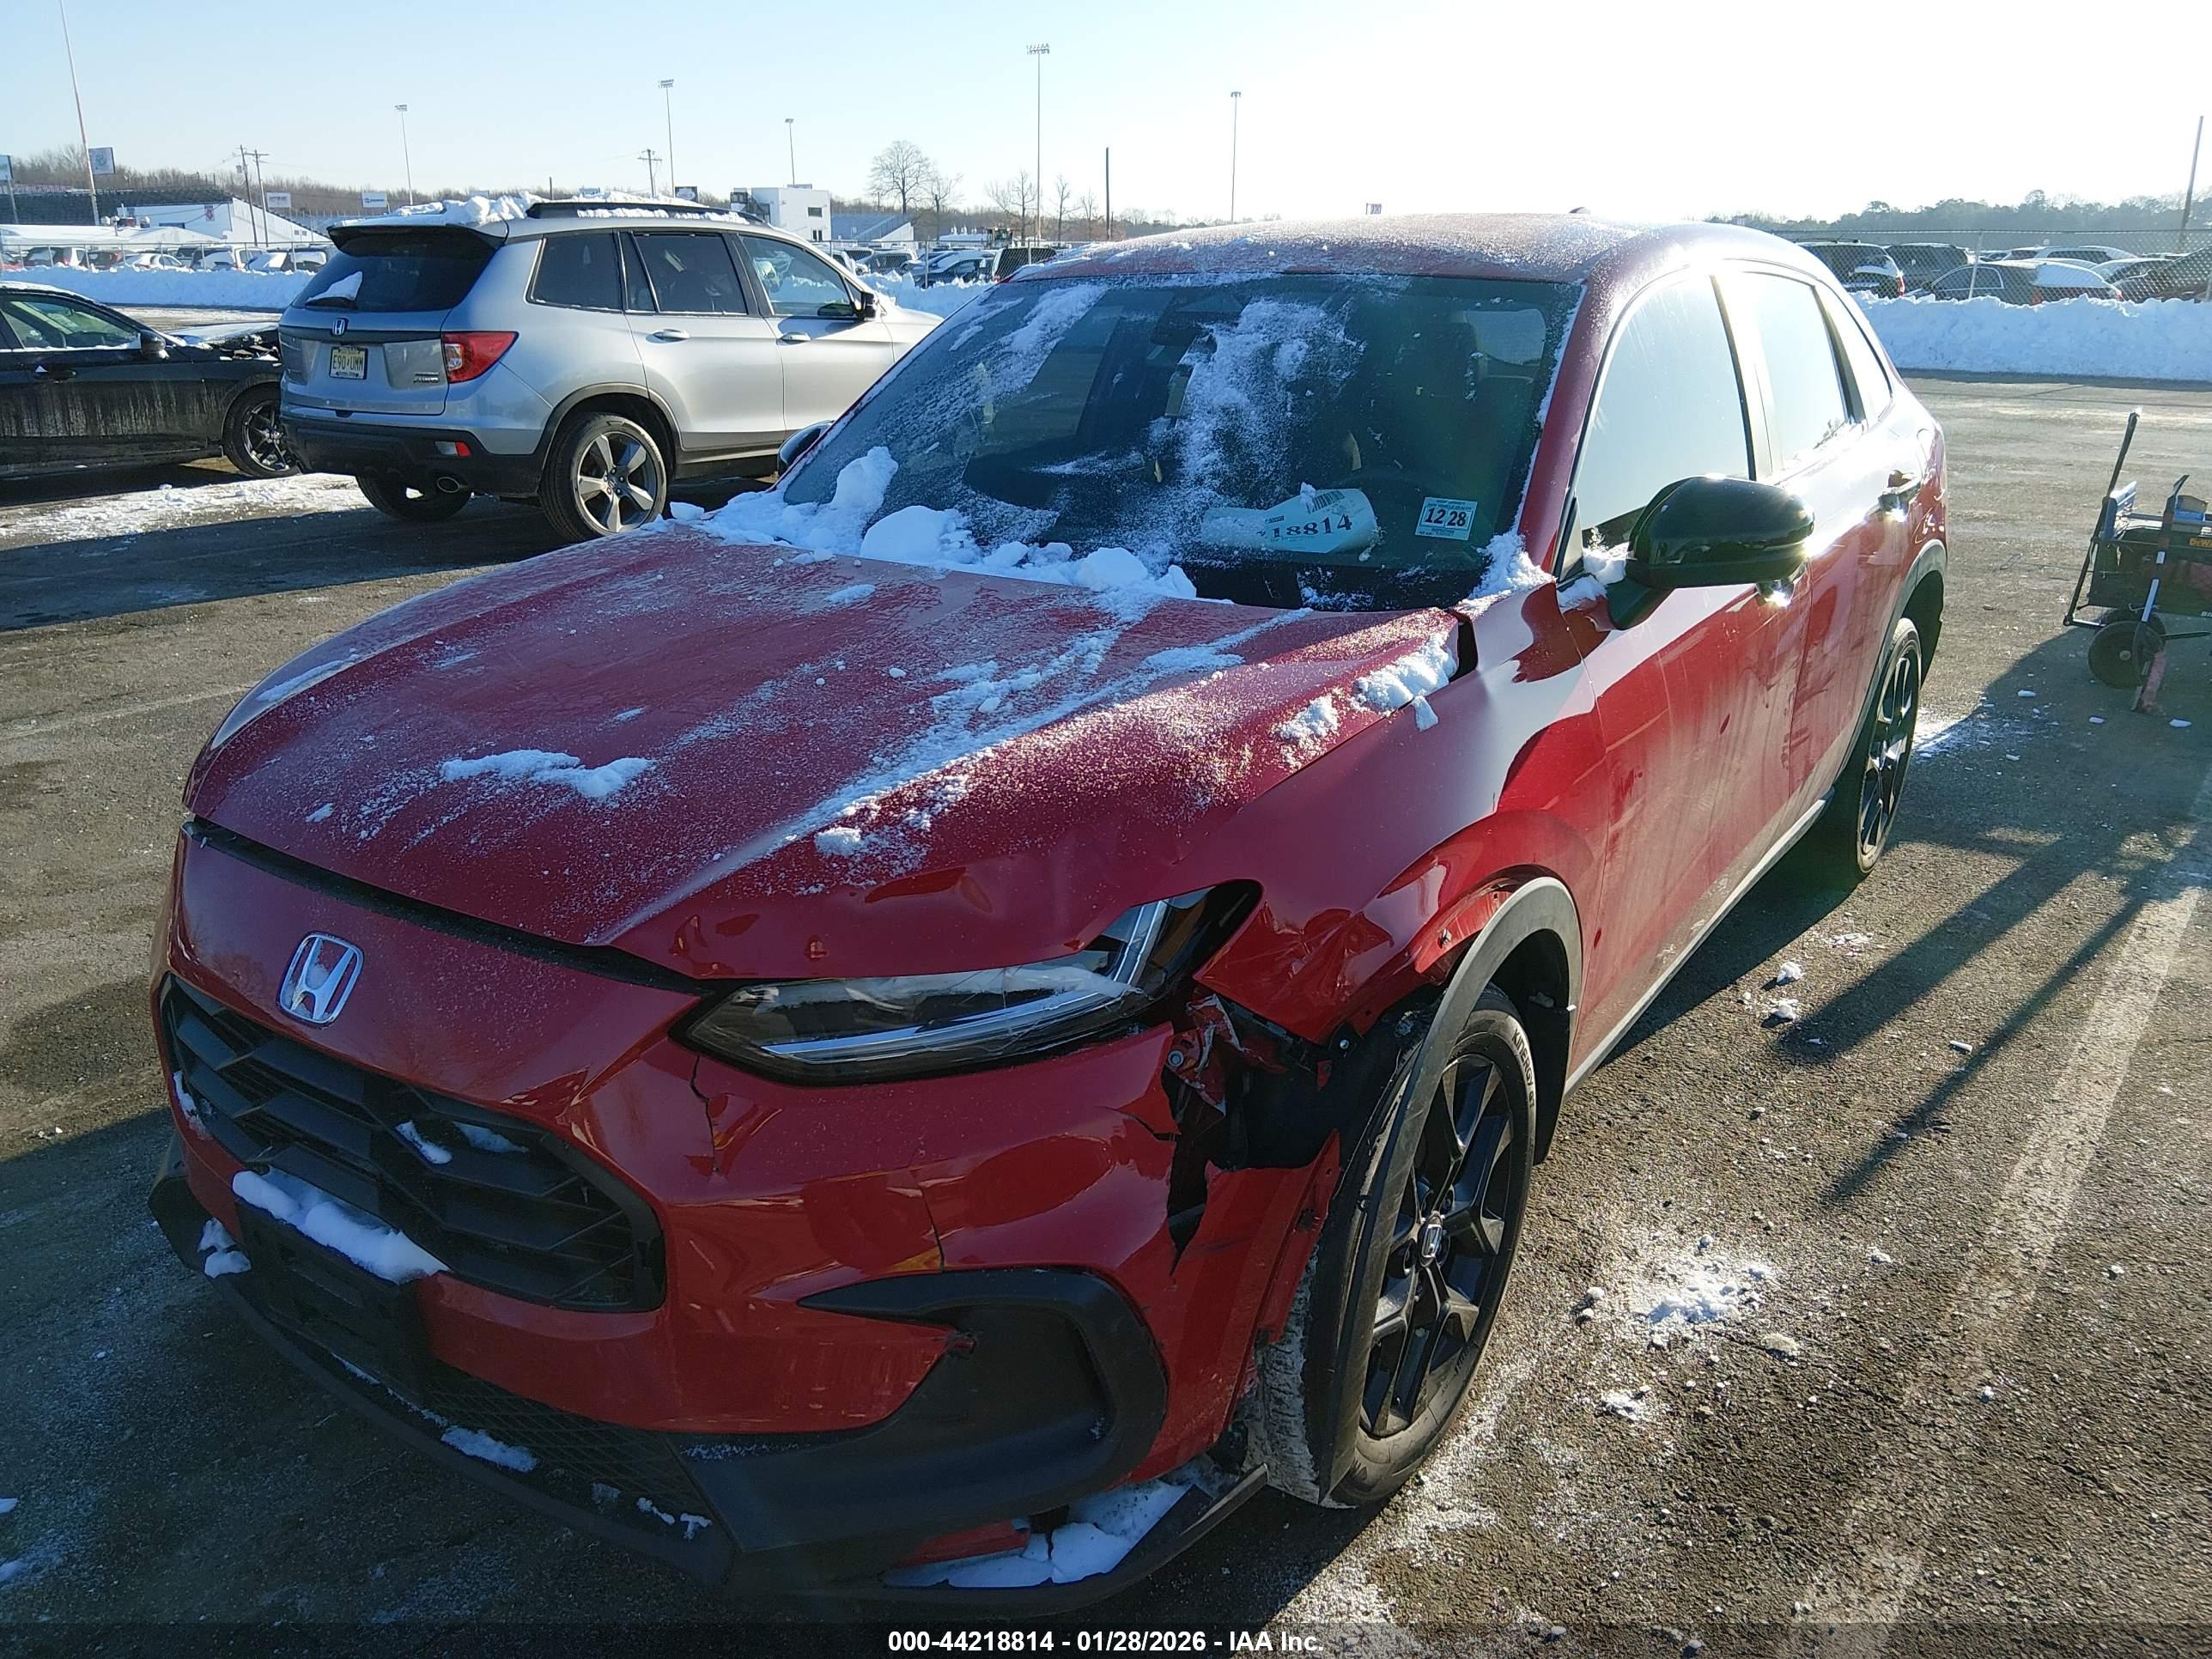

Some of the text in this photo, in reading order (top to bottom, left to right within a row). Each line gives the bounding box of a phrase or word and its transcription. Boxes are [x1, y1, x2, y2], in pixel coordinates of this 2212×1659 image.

[333, 355, 346, 370] E90
[1422, 507, 1468, 527] 12 28
[1511, 1028, 1534, 1086] KINERGY
